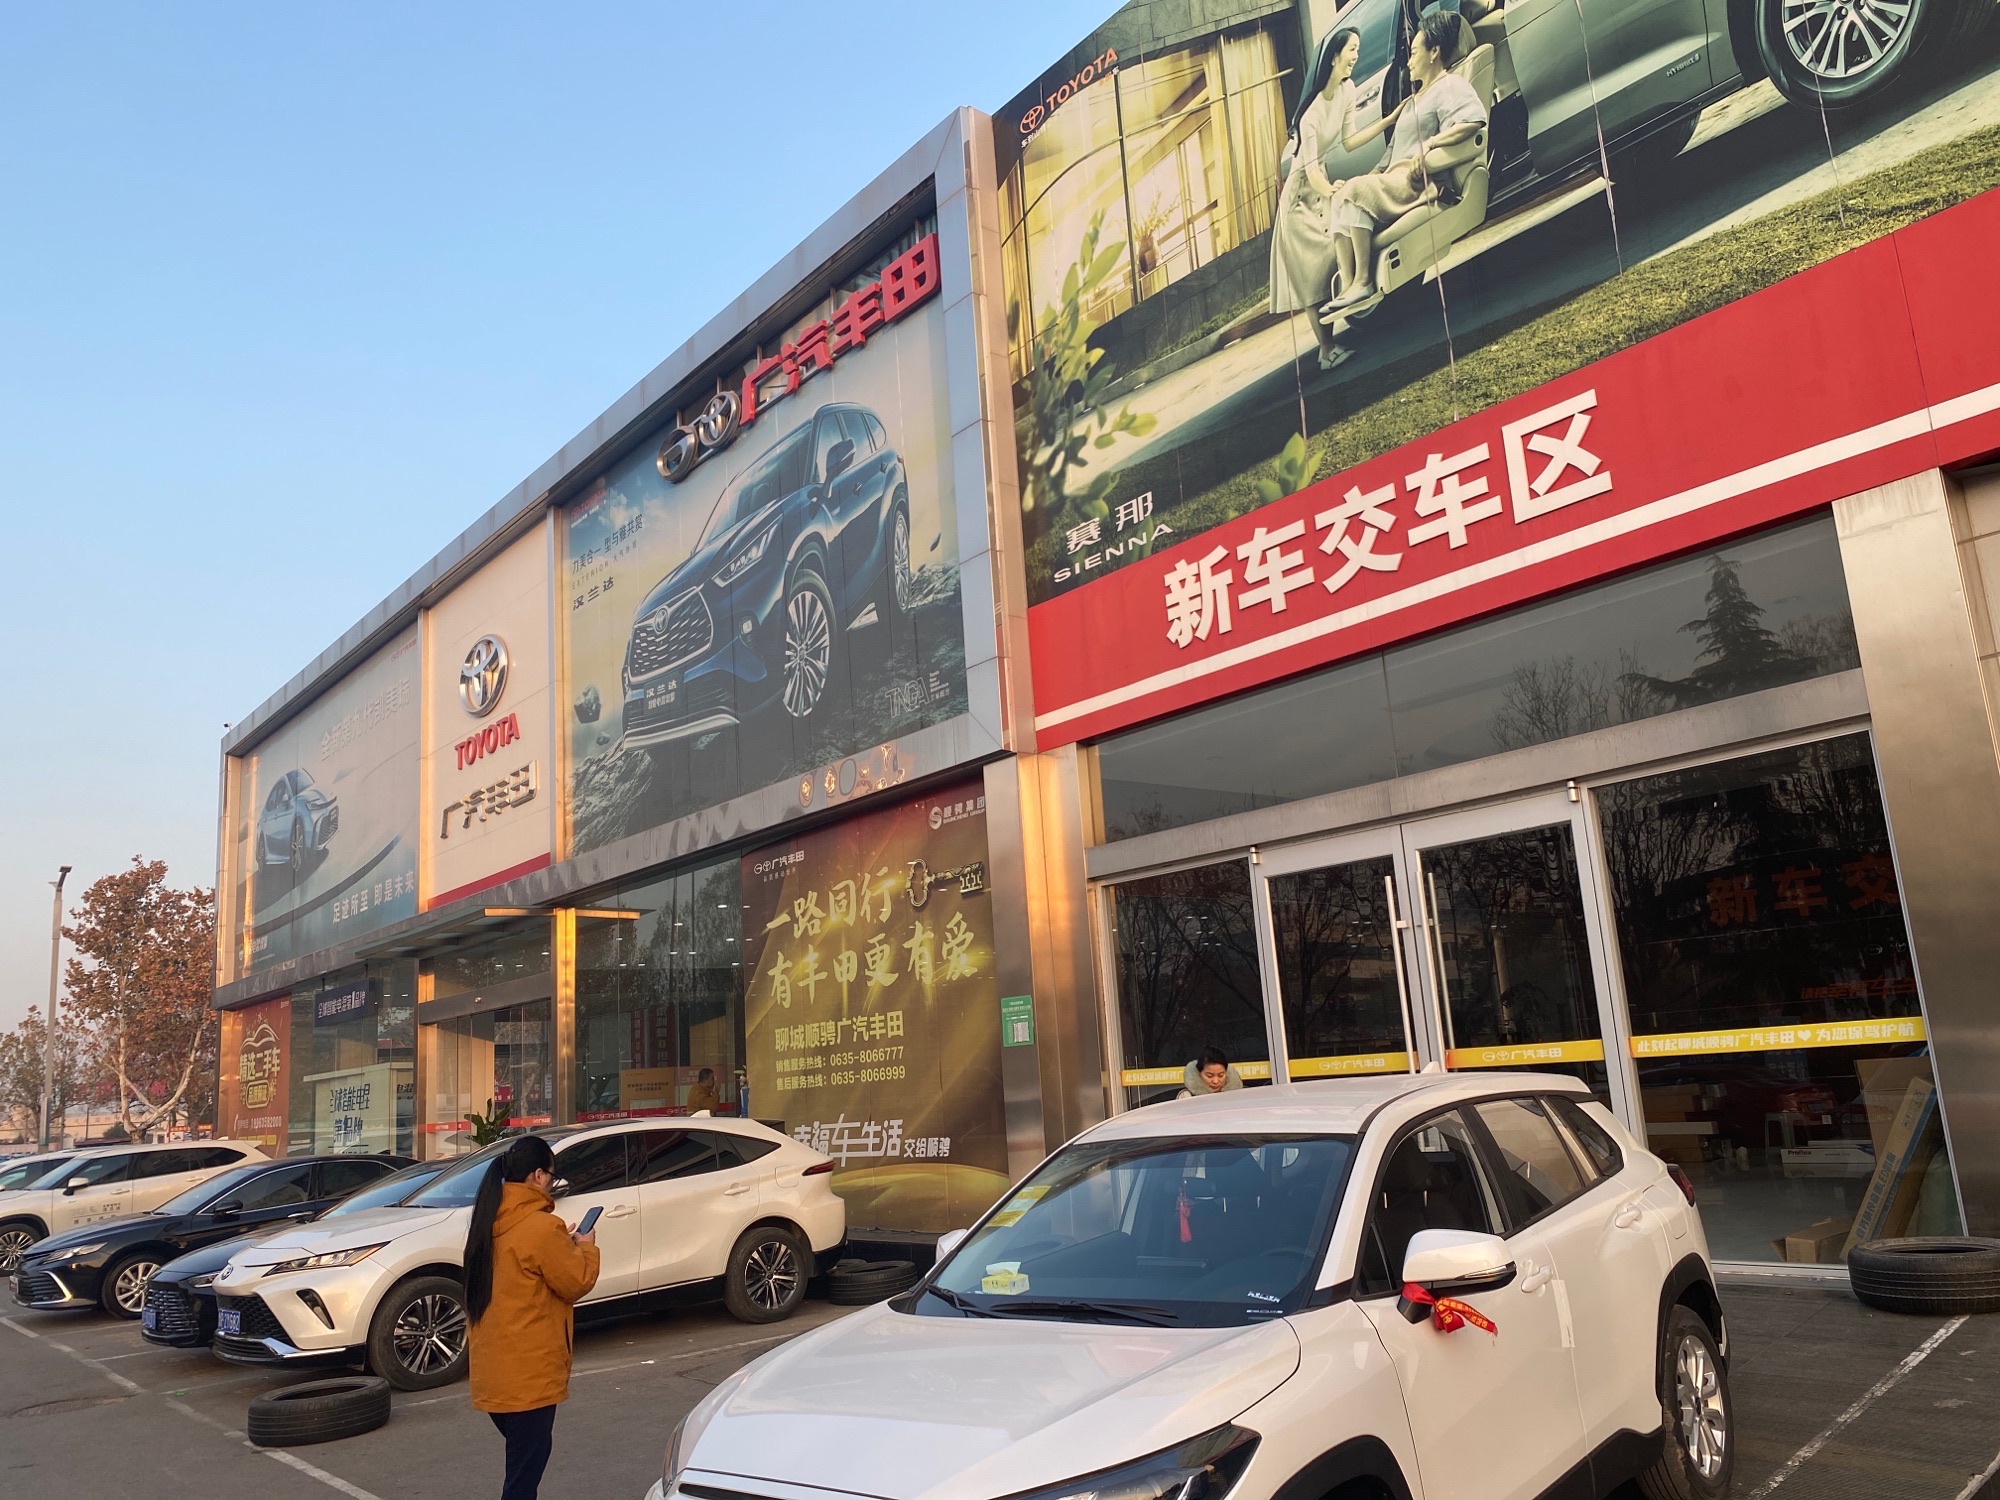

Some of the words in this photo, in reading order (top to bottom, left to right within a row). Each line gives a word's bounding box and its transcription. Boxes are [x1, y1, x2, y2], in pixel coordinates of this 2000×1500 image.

[1046, 47, 1118, 111] TOYOTA
[740, 232, 941, 426] 广汽丰田
[1163, 388, 1613, 650] 新车交车区
[1053, 522, 1173, 584] SIENNA
[572, 576, 614, 611] 汉兰达
[454, 712, 521, 771] TOYOTA
[772, 850, 805, 870] 广汽丰田
[374, 869, 415, 905] 即是未来
[766, 866, 893, 939] 一路同行
[775, 1010, 905, 1052] 聊城顺骋广汽丰田
[830, 1046, 904, 1067] 0635-8066777
[1342, 1057, 1386, 1069] 广汽丰田
[1511, 1048, 1563, 1061] 广汽丰田
[830, 1065, 906, 1086] 0635-8066999
